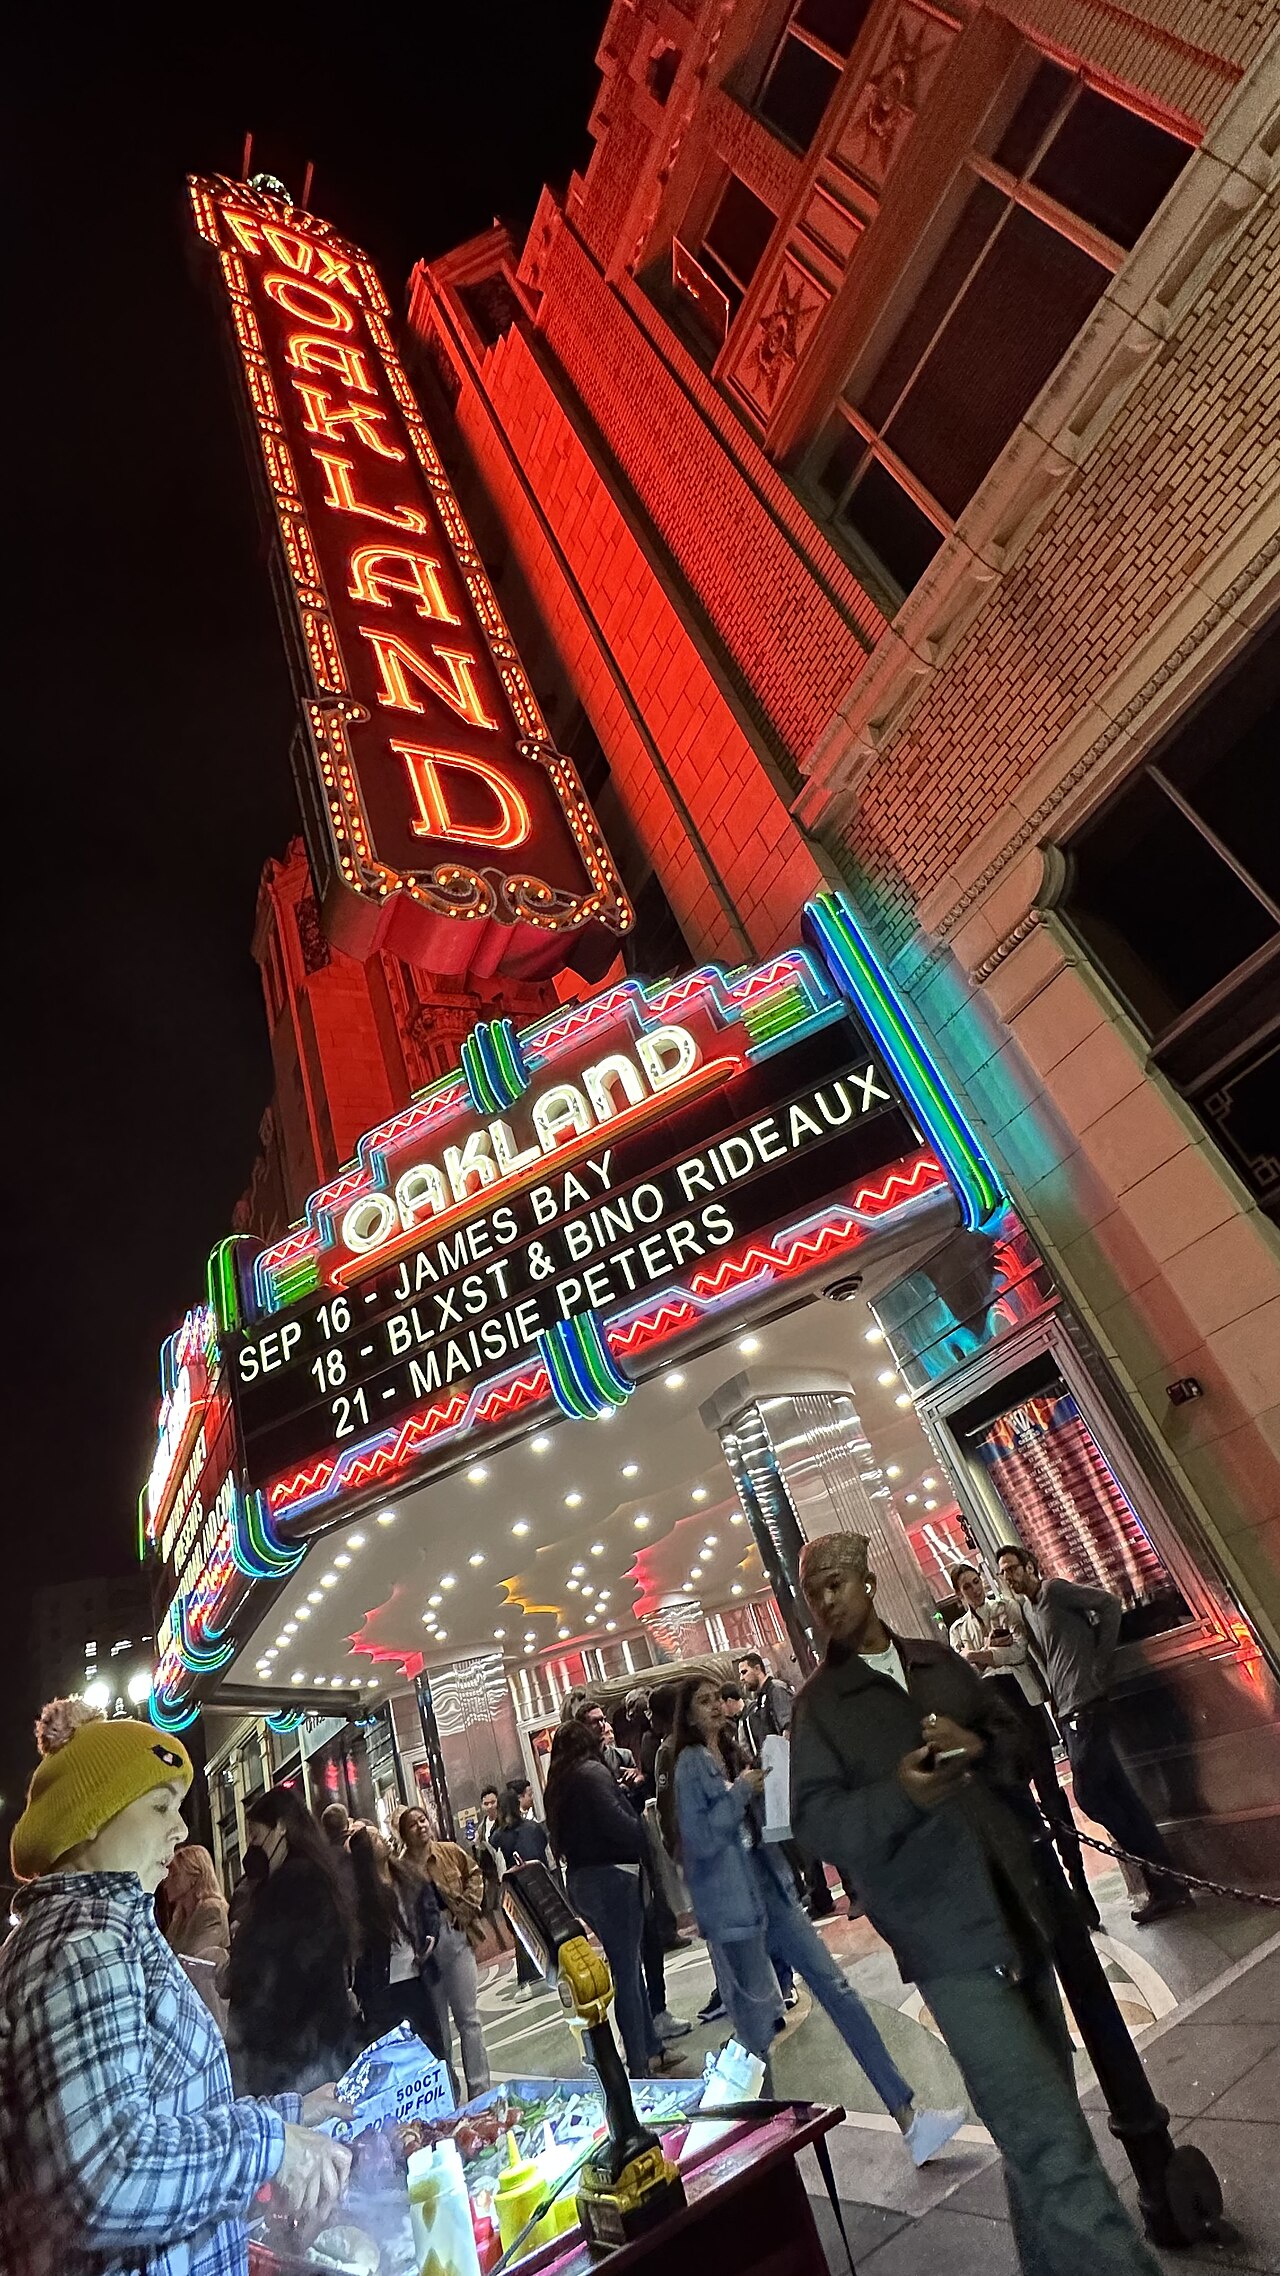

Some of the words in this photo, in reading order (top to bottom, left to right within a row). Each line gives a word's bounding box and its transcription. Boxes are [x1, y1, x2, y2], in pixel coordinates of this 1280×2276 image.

[221, 209, 362, 298] FOX
[264, 271, 533, 850] OAKLAND
[311, 1349, 347, 1394] 18
[386, 1258, 510, 1357] BLXST
[528, 1245, 556, 1281] &
[564, 1183, 664, 1262] BINO
[676, 1064, 891, 1202] RIDEAUX
[341, 1025, 704, 1254] OAKLAND
[238, 1320, 302, 1383] SEP
[316, 1296, 351, 1341] 16
[394, 1207, 517, 1301] JAMES
[529, 1149, 613, 1227] BAY
[332, 1387, 370, 1439] 21
[409, 1300, 545, 1399] MAISIE
[556, 1204, 735, 1321] PETERS
[396, 2100, 413, 2119] UP
[416, 2085, 445, 2110] FOIL
[397, 2069, 441, 2102] 500CT
